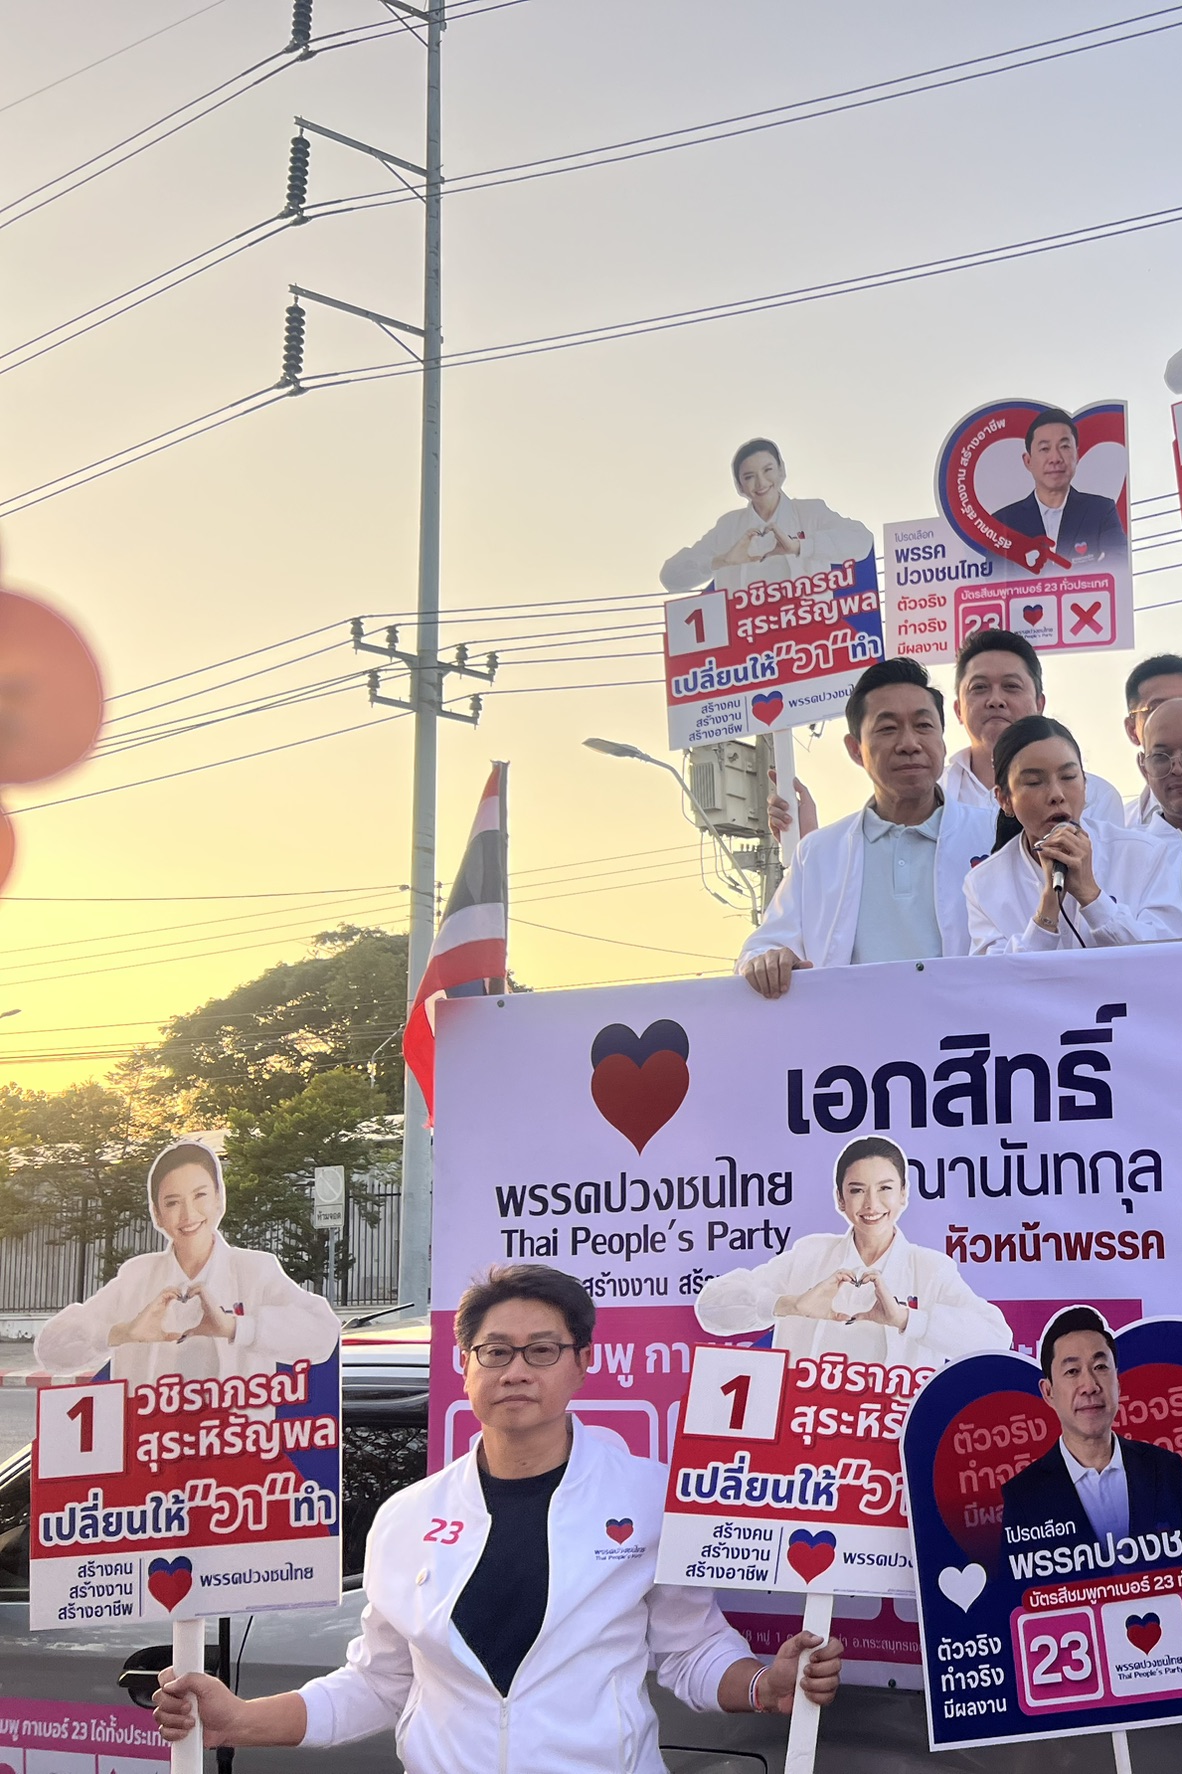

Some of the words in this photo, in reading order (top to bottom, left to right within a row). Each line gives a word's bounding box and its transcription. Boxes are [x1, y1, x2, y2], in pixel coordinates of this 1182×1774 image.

[960, 418, 1006, 467] สร้างอาชีพ
[895, 529, 935, 544] โปรดเลือก
[895, 543, 946, 564] พรรค
[734, 560, 855, 609] วชิราภรณ์
[896, 559, 994, 587] ปวงชนไทย
[1044, 583, 1058, 593] 23
[1060, 578, 1109, 591] ทั่วประเทศ
[897, 594, 947, 612] ตัวจริง
[684, 608, 705, 643] 1
[737, 592, 878, 643] สุระหิรัญพล
[898, 618, 947, 636] ทำจริง
[964, 612, 1000, 639] 23
[897, 640, 948, 656] มีผลงาน
[701, 698, 741, 715] สร้างคน
[788, 683, 855, 708] พรรคปวงชนไ
[688, 723, 743, 742] สร้างอาชีพ
[696, 712, 742, 729] สร้างงาน
[787, 1002, 1127, 1135] เอกสิทธิ์
[495, 1155, 792, 1218] พรรคปวงชนไทย
[907, 1137, 1162, 1214] ณานันทกุล
[501, 1227, 558, 1258] Thai
[571, 1218, 694, 1262] People's
[708, 1218, 791, 1255] Party
[945, 1221, 1165, 1263] หัวหน้าพรรค
[582, 1271, 668, 1298] สร้างงาน
[136, 1361, 308, 1415] วชิราภรณ์
[720, 1374, 751, 1430] 1
[66, 1396, 94, 1453] 1
[953, 1414, 1047, 1455] ตัวจริง
[137, 1417, 336, 1473] สุระหิรัญพล
[423, 1518, 464, 1545] 23
[713, 1522, 773, 1541] สร้างคน
[1005, 1519, 1076, 1543] โปรดเลือก
[701, 1542, 770, 1561] สร้างงาน
[77, 1560, 133, 1578] สร้างคน
[200, 1562, 314, 1588] พรรคปวงชนไทย
[685, 1562, 768, 1582] สร้างอาชีพ
[69, 1580, 133, 1599] สร้างงาน
[1029, 1575, 1151, 1608] บัตรสีชมพูกาเบอร์
[1154, 1575, 1174, 1590] 23
[58, 1599, 133, 1620] สร้างอาชีพ
[937, 1633, 1001, 1661] ตัวจริง
[1030, 1631, 1092, 1685] 23
[940, 1663, 1005, 1692] ทำจริง
[1115, 1655, 1182, 1675] พรรคปวงชนไทย
[1118, 1671, 1132, 1680] Thai
[943, 1696, 1007, 1719] มีผลงาน
[22, 1718, 70, 1739] กาเบอร์
[71, 1722, 88, 1740] 23
